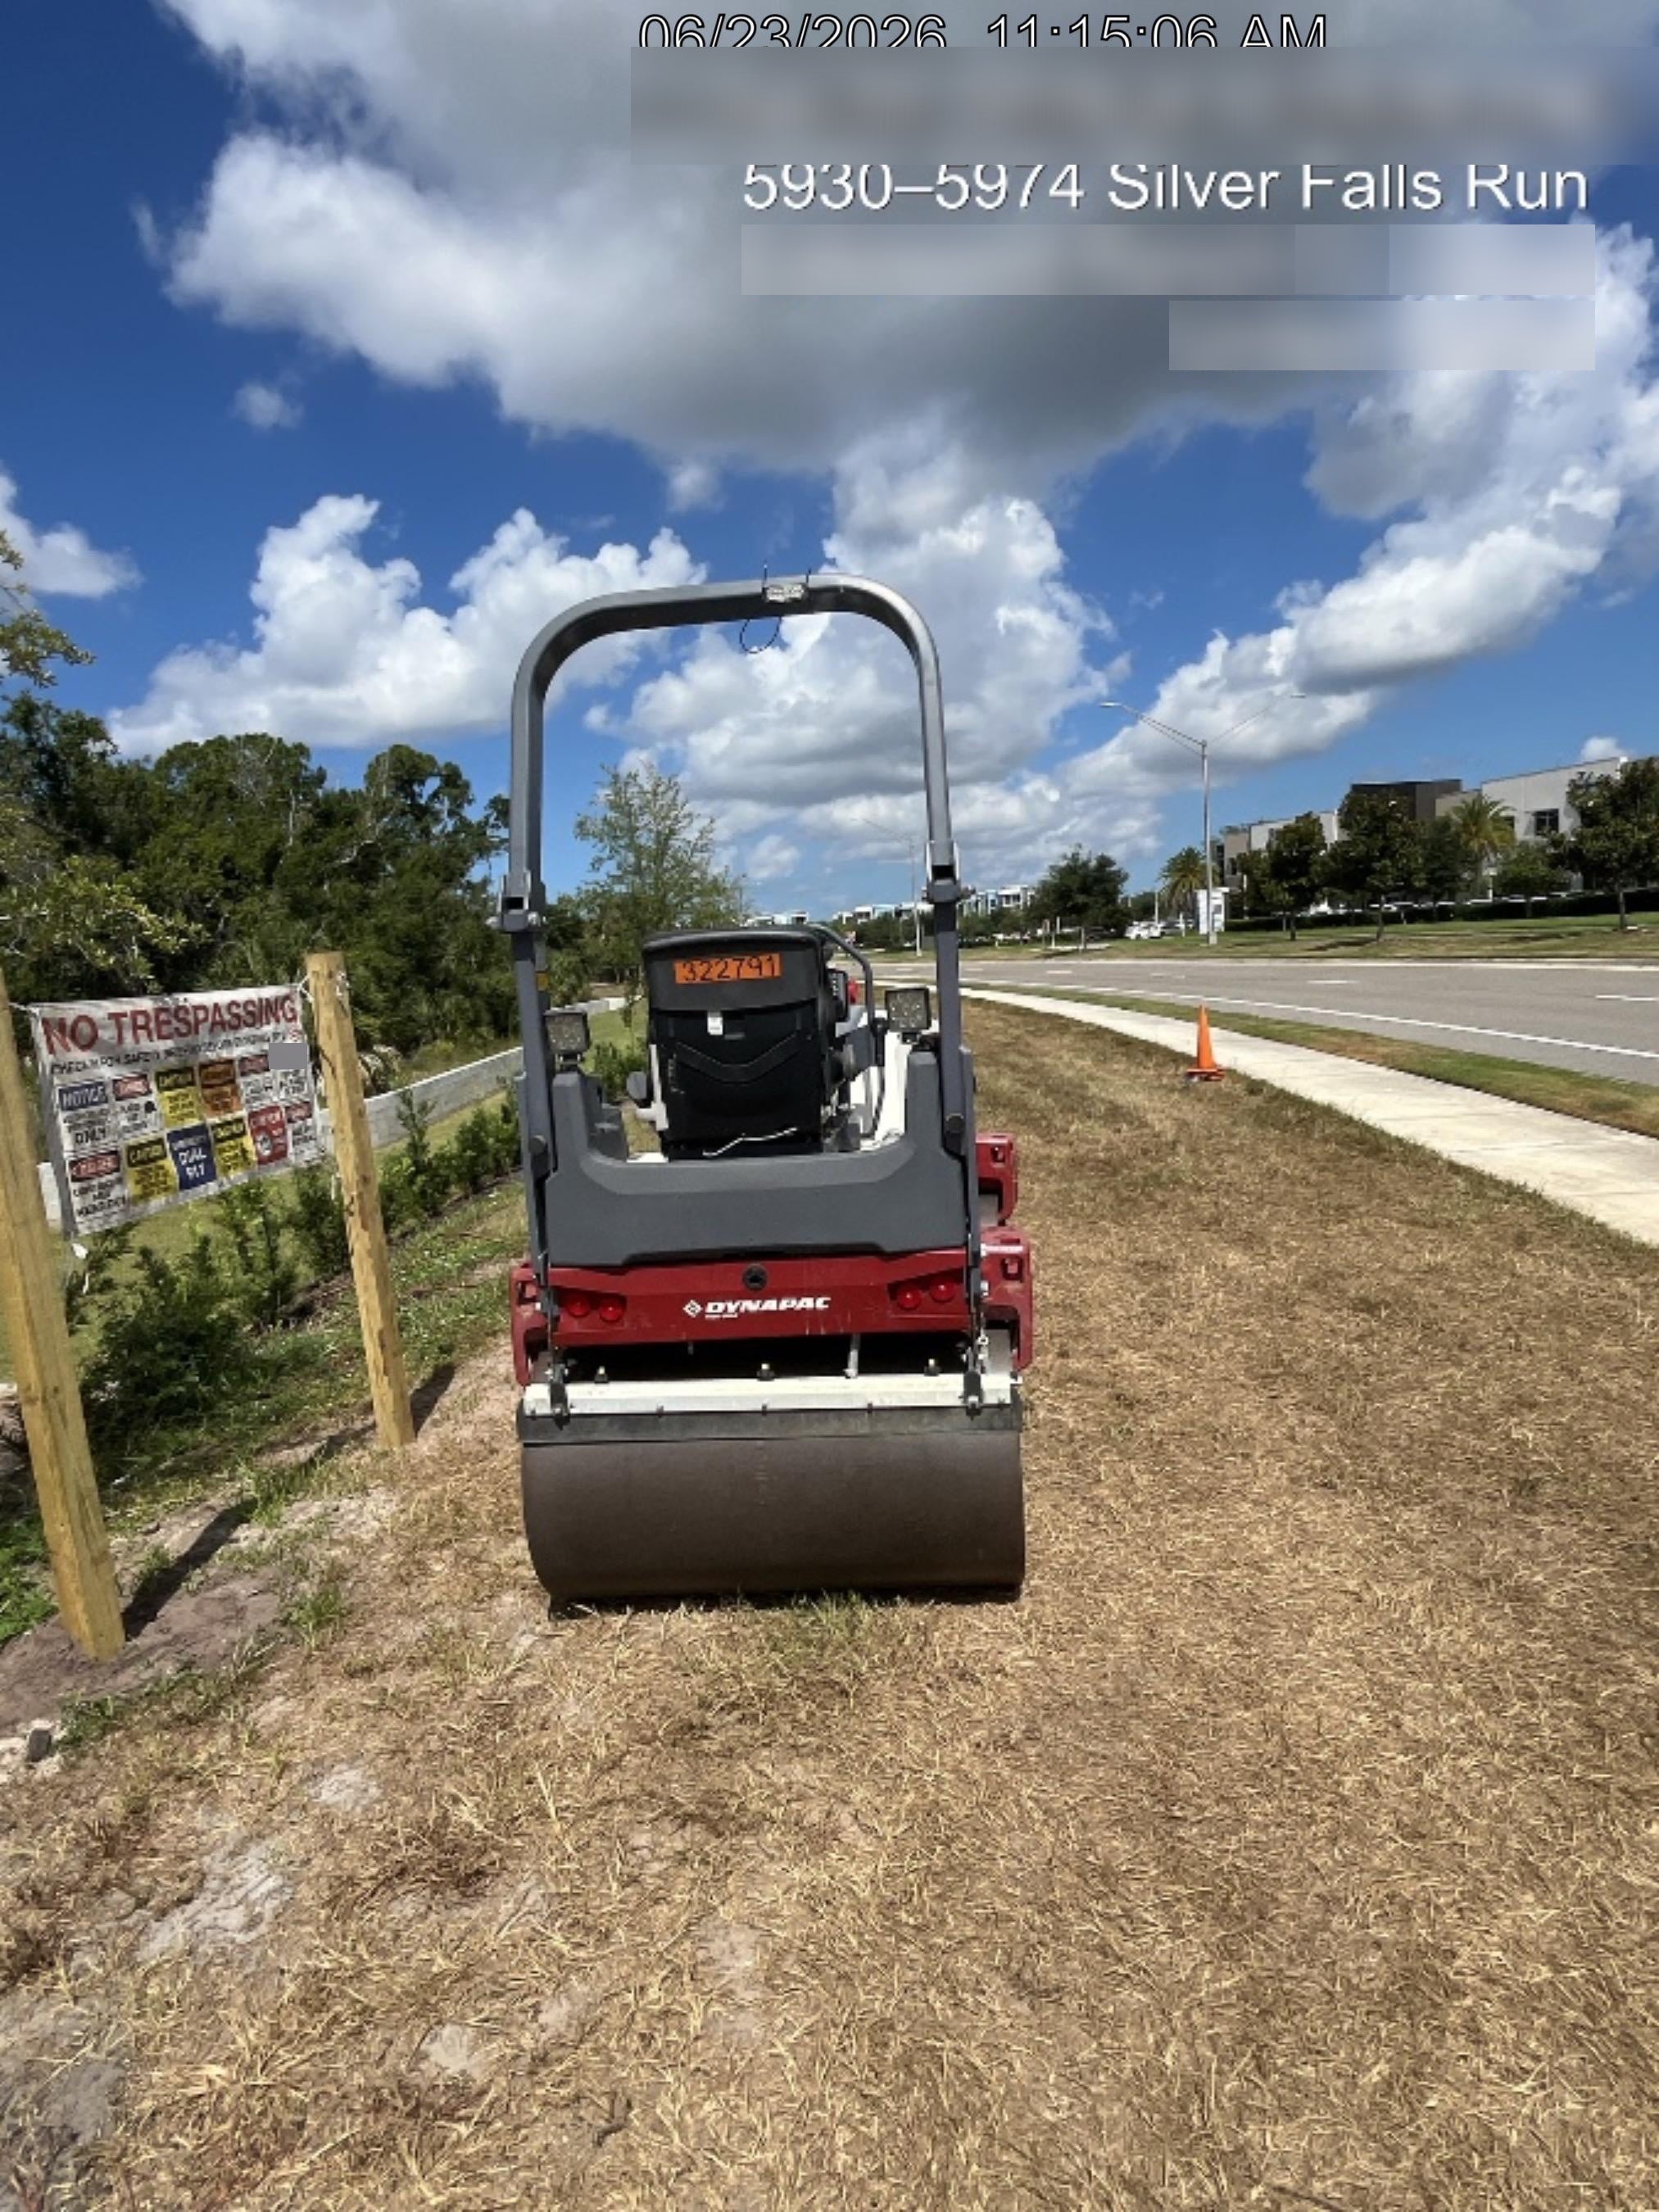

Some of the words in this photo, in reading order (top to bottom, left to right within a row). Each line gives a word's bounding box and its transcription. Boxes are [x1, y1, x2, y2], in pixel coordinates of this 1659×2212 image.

[682, 955, 775, 981] 322791
[42, 1014, 98, 1054] NO
[107, 991, 297, 1045] TRESPASSING
[705, 1297, 832, 1314] DYNAPAC
